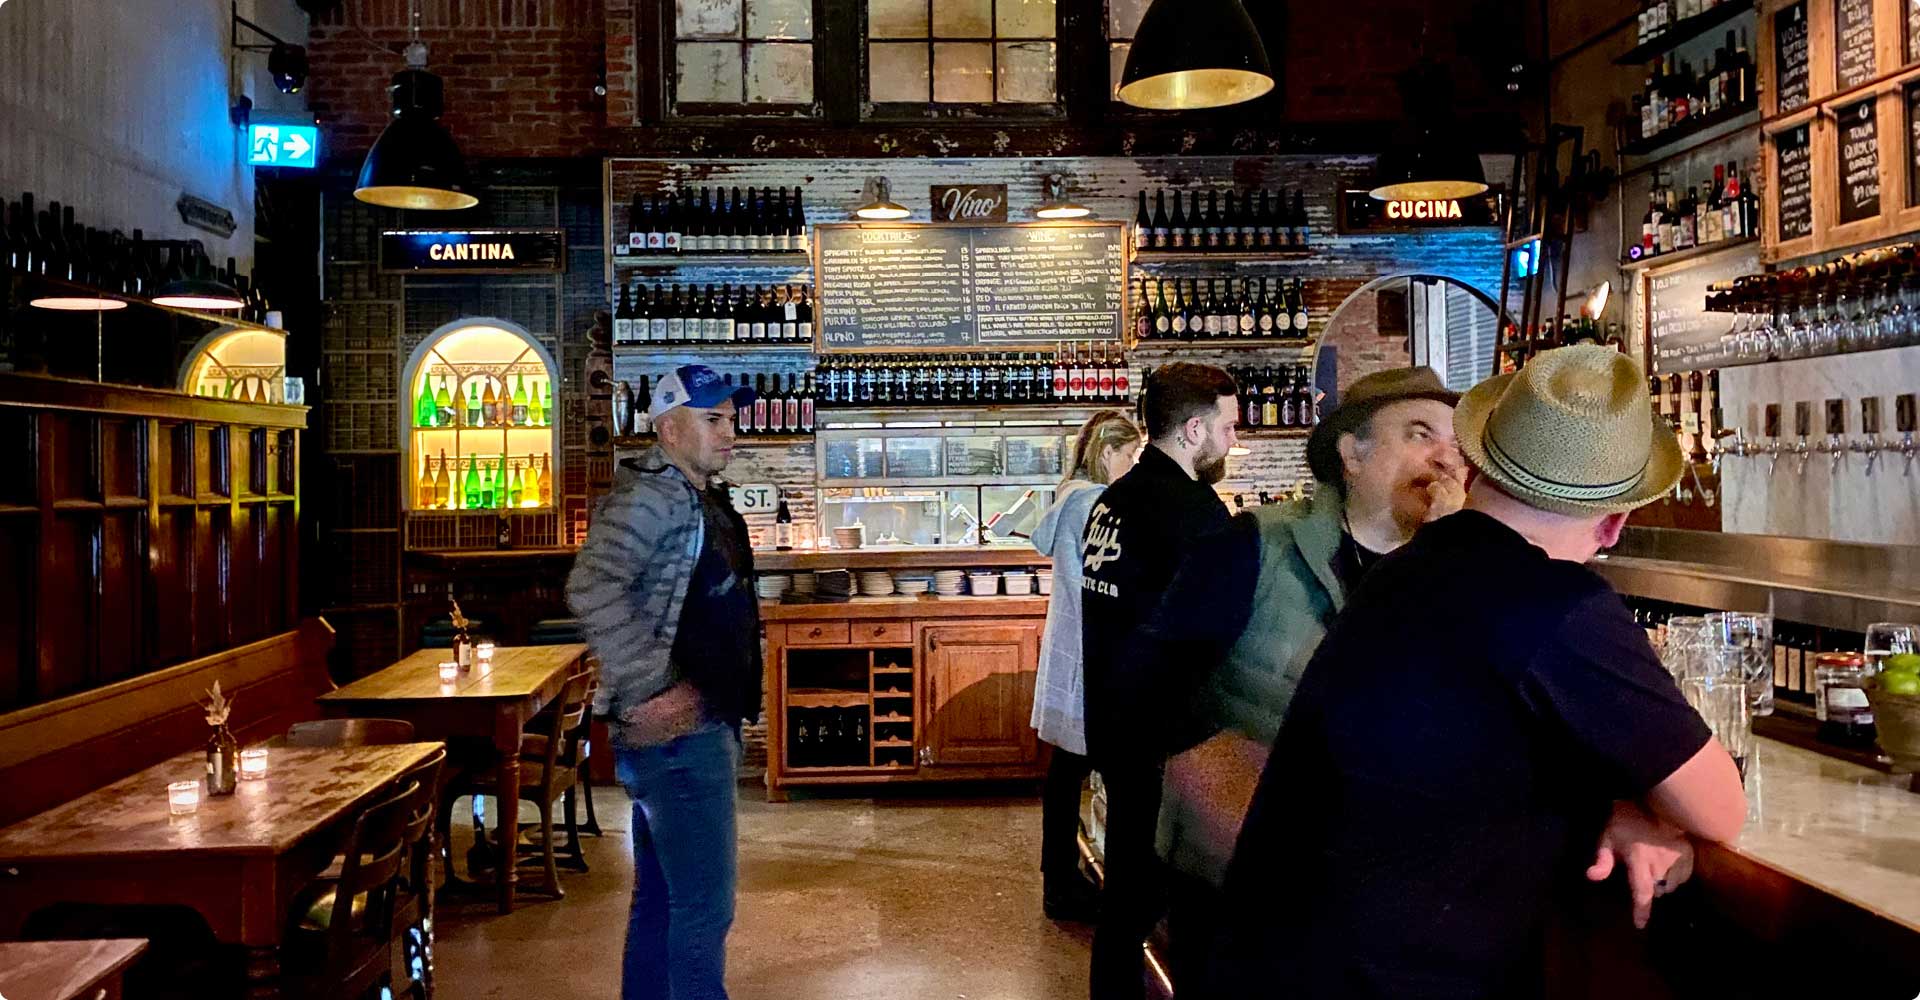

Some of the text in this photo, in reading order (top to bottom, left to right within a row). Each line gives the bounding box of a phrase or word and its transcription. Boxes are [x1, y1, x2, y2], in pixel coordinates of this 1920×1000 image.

[942, 188, 1002, 222] Vino
[1387, 200, 1463, 218] CUCINA
[1028, 231, 1056, 242] WINE
[430, 243, 515, 260] CANTINA
[977, 304, 991, 312] RED
[824, 316, 858, 326] PURPLE
[744, 489, 769, 507] ST.
